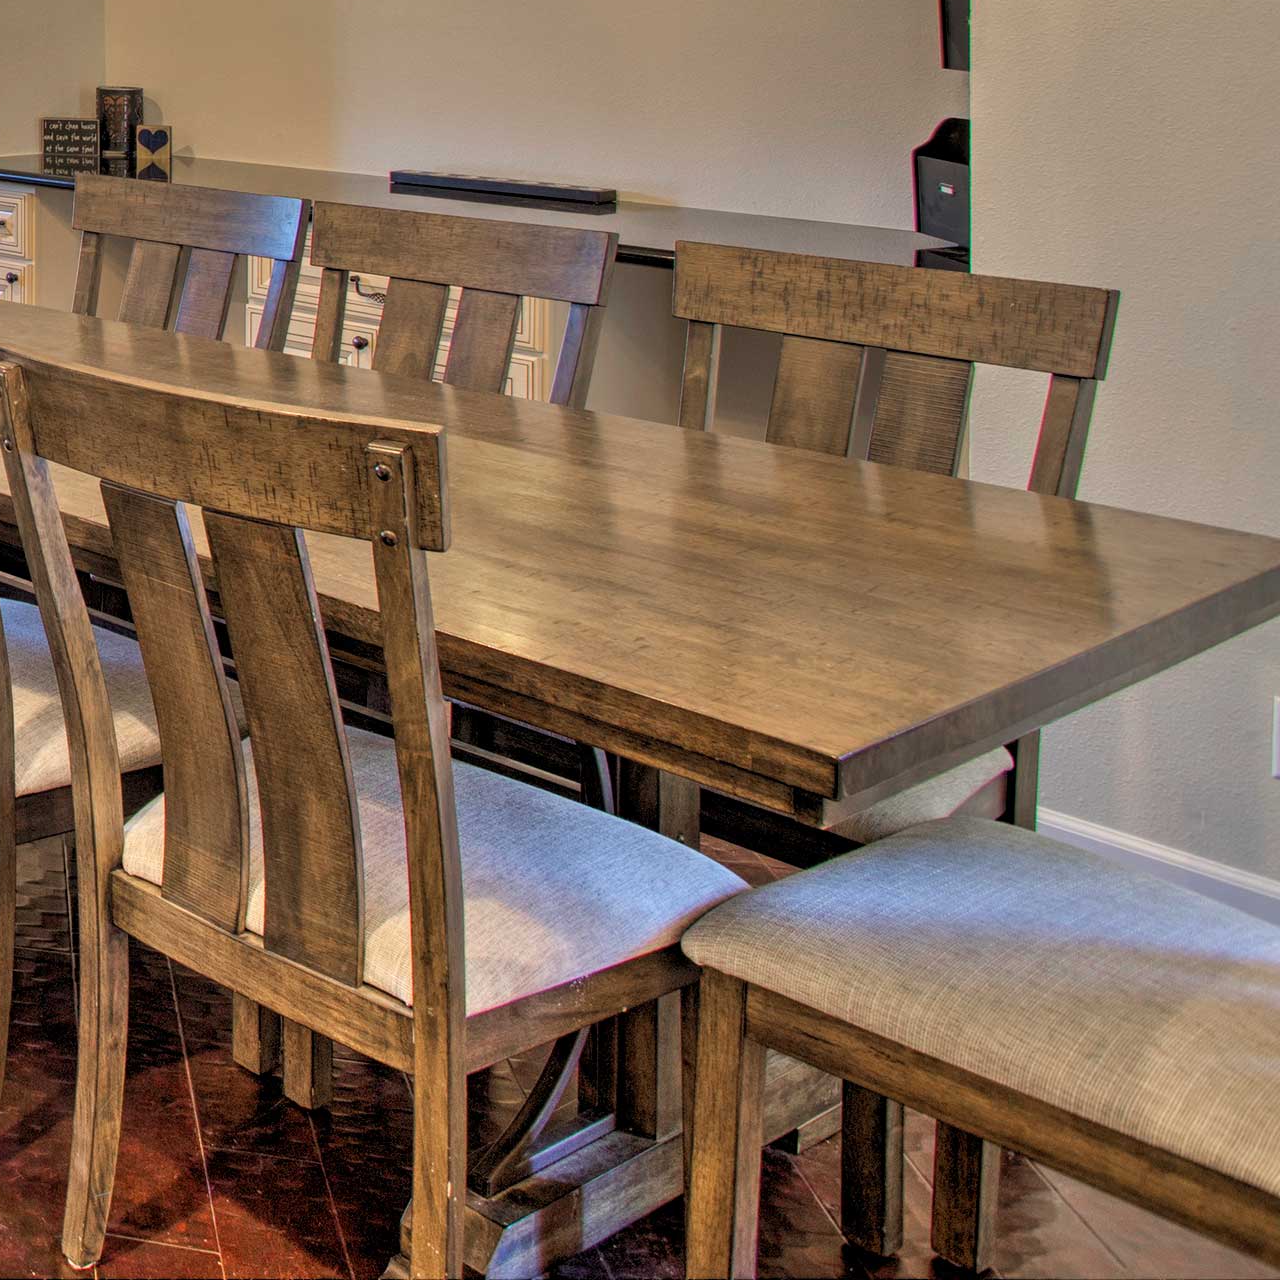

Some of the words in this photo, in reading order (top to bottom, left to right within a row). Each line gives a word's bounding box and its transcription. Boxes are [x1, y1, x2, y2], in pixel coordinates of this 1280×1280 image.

[49, 120, 62, 130] can't
[44, 132, 53, 141] and
[71, 132, 80, 142] the
[82, 133, 97, 143] world
[46, 145, 52, 153] at
[55, 144, 64, 153] the
